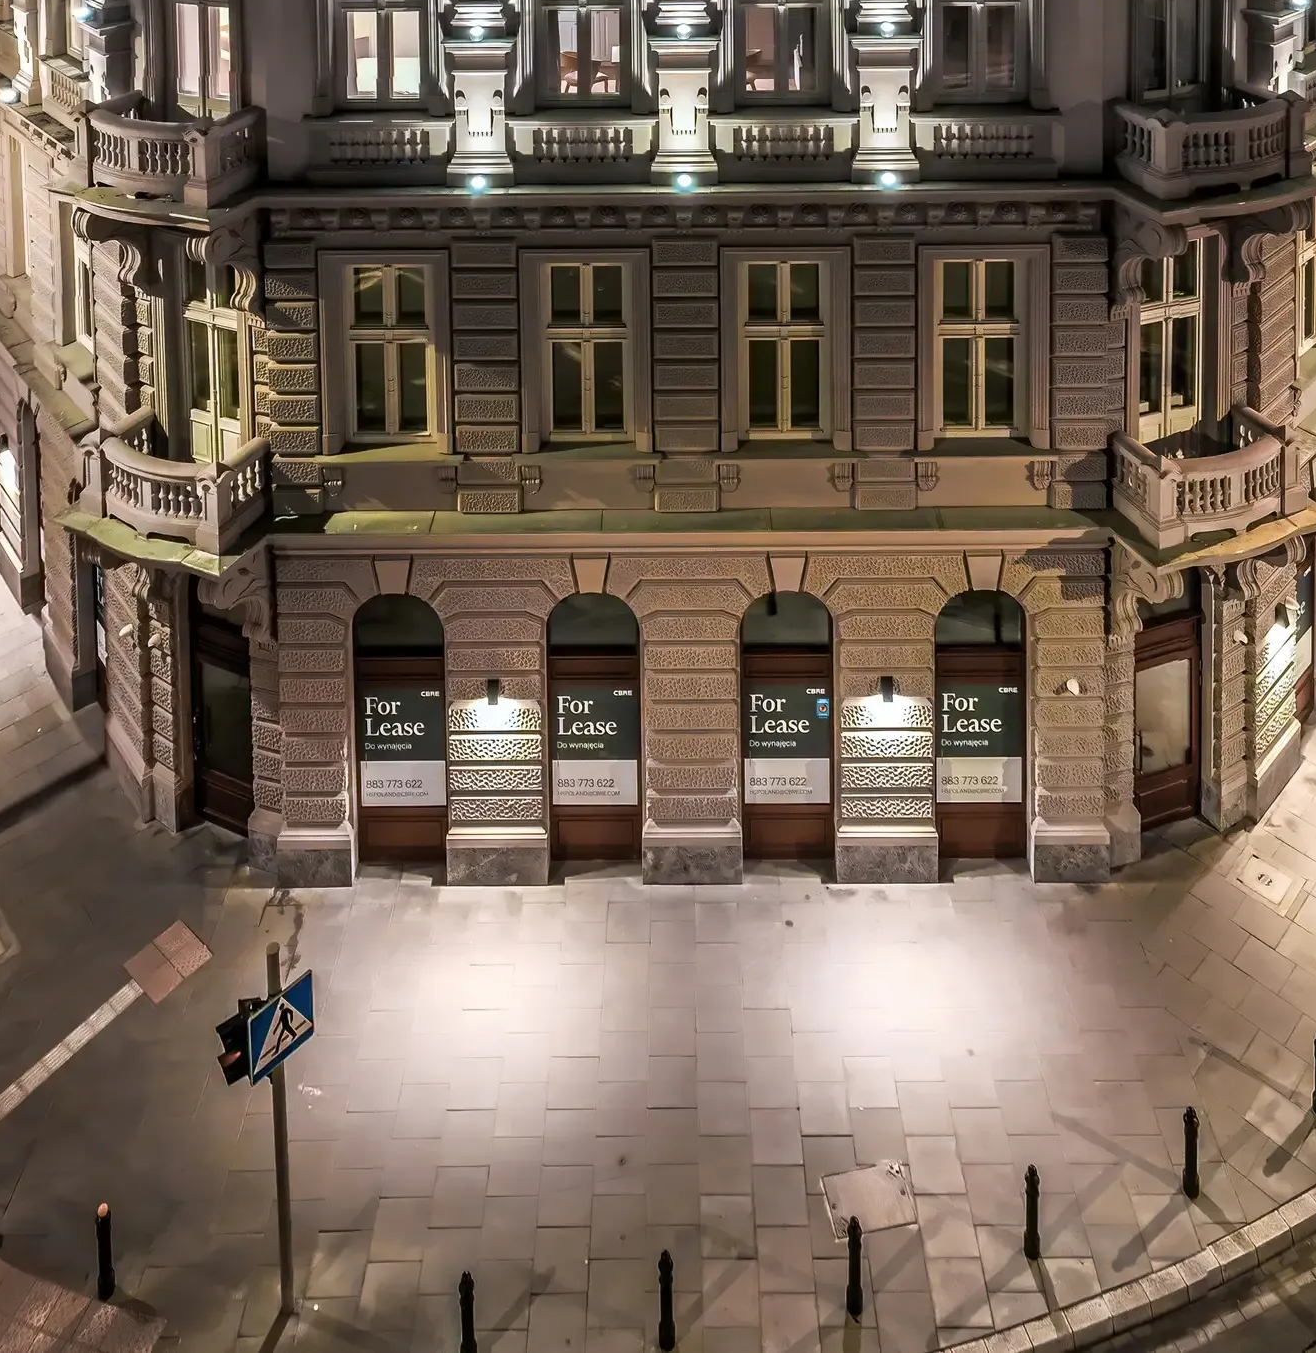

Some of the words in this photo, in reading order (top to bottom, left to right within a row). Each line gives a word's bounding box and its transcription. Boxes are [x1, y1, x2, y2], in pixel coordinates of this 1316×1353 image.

[364, 696, 401, 715] For
[556, 695, 594, 714] For
[749, 693, 786, 712] For
[941, 693, 979, 712] For
[365, 717, 426, 736] Lease
[557, 716, 618, 735] Lease
[749, 715, 810, 734] Lease
[941, 714, 1002, 733] Lease
[377, 743, 413, 751] wynajęcia
[569, 742, 604, 750] wynajęcia
[749, 739, 760, 747] Do
[761, 740, 797, 748] wynajęcia
[953, 739, 989, 747] wynajęcia
[365, 779, 384, 789] 883
[385, 779, 403, 789] 773
[405, 779, 423, 789] 622
[557, 778, 576, 787] 883
[577, 778, 595, 787] 773
[596, 778, 615, 787] 622
[749, 777, 767, 786] 883
[769, 777, 787, 786] 773
[788, 777, 807, 786] 622
[941, 776, 959, 785] 883
[961, 776, 979, 785] 773
[980, 776, 998, 785] 622
